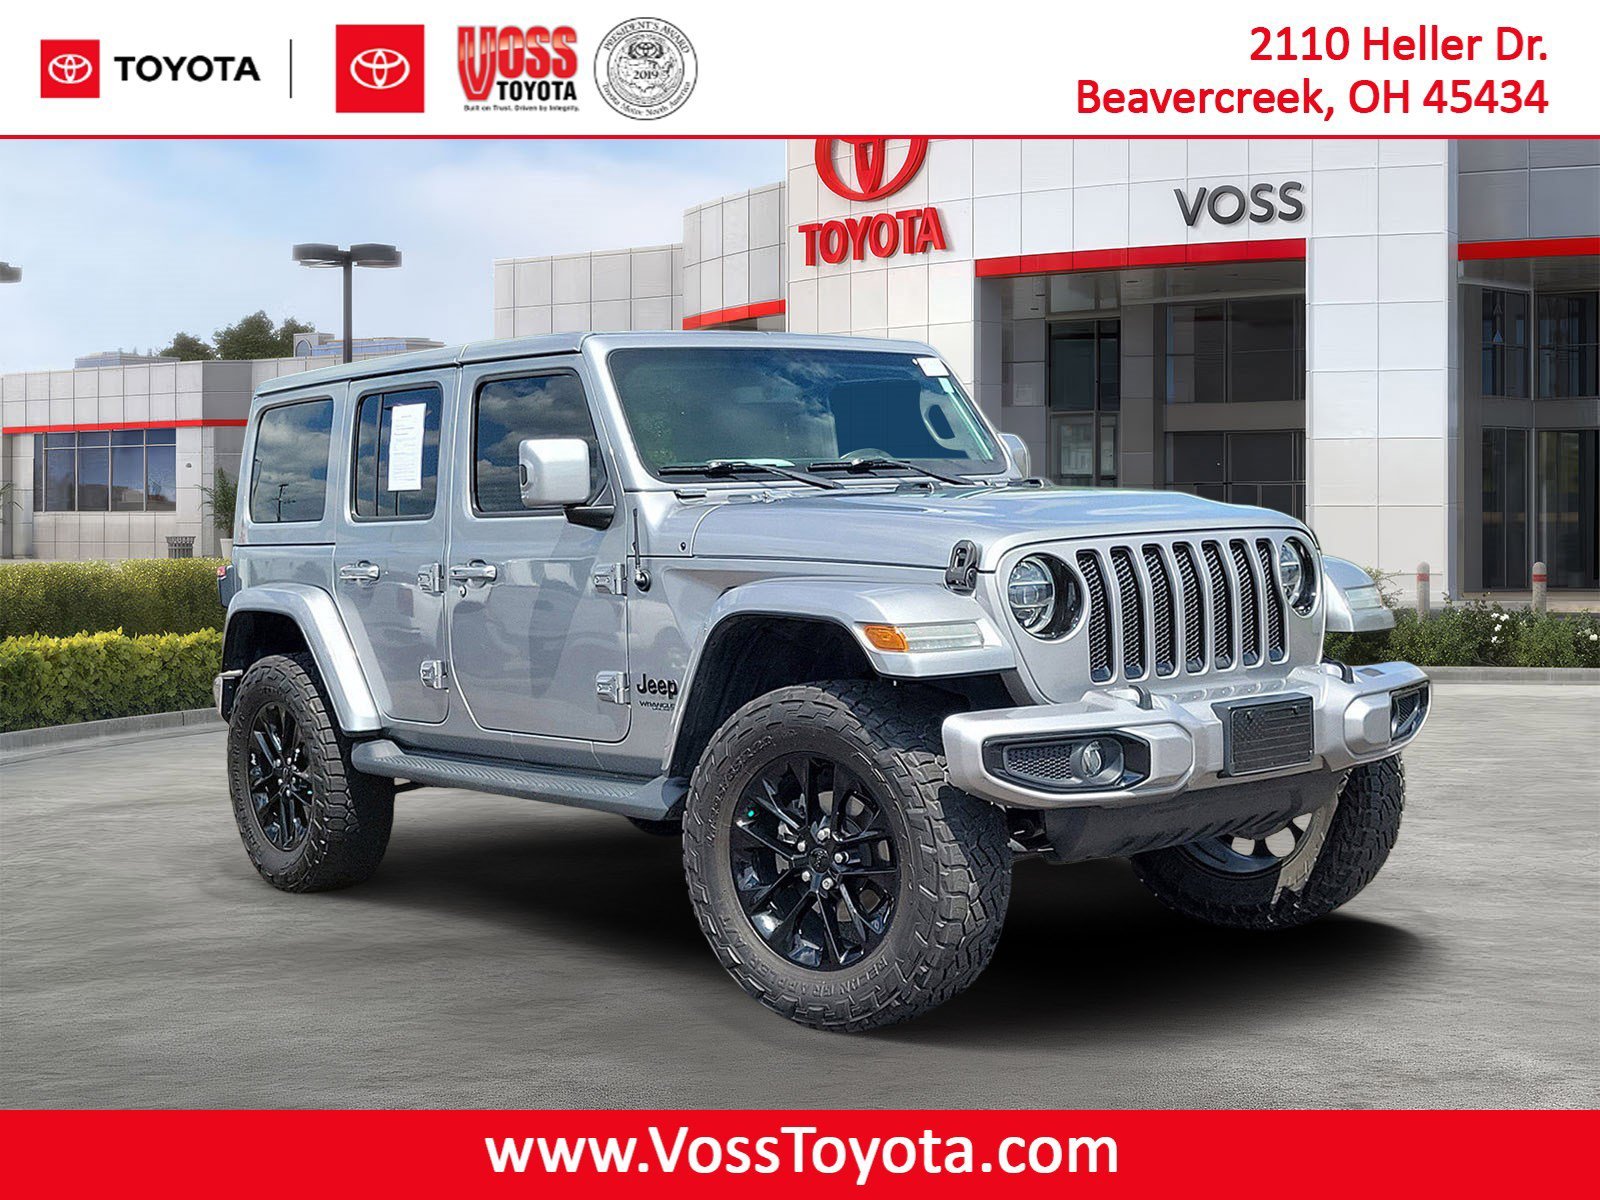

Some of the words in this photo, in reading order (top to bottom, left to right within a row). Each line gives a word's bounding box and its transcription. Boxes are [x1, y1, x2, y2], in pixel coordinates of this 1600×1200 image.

[1173, 180, 1307, 228] VOSS
[798, 207, 948, 267] TOYOTA
[636, 673, 678, 700] Jeep
[639, 700, 676, 708] WRANGLE
